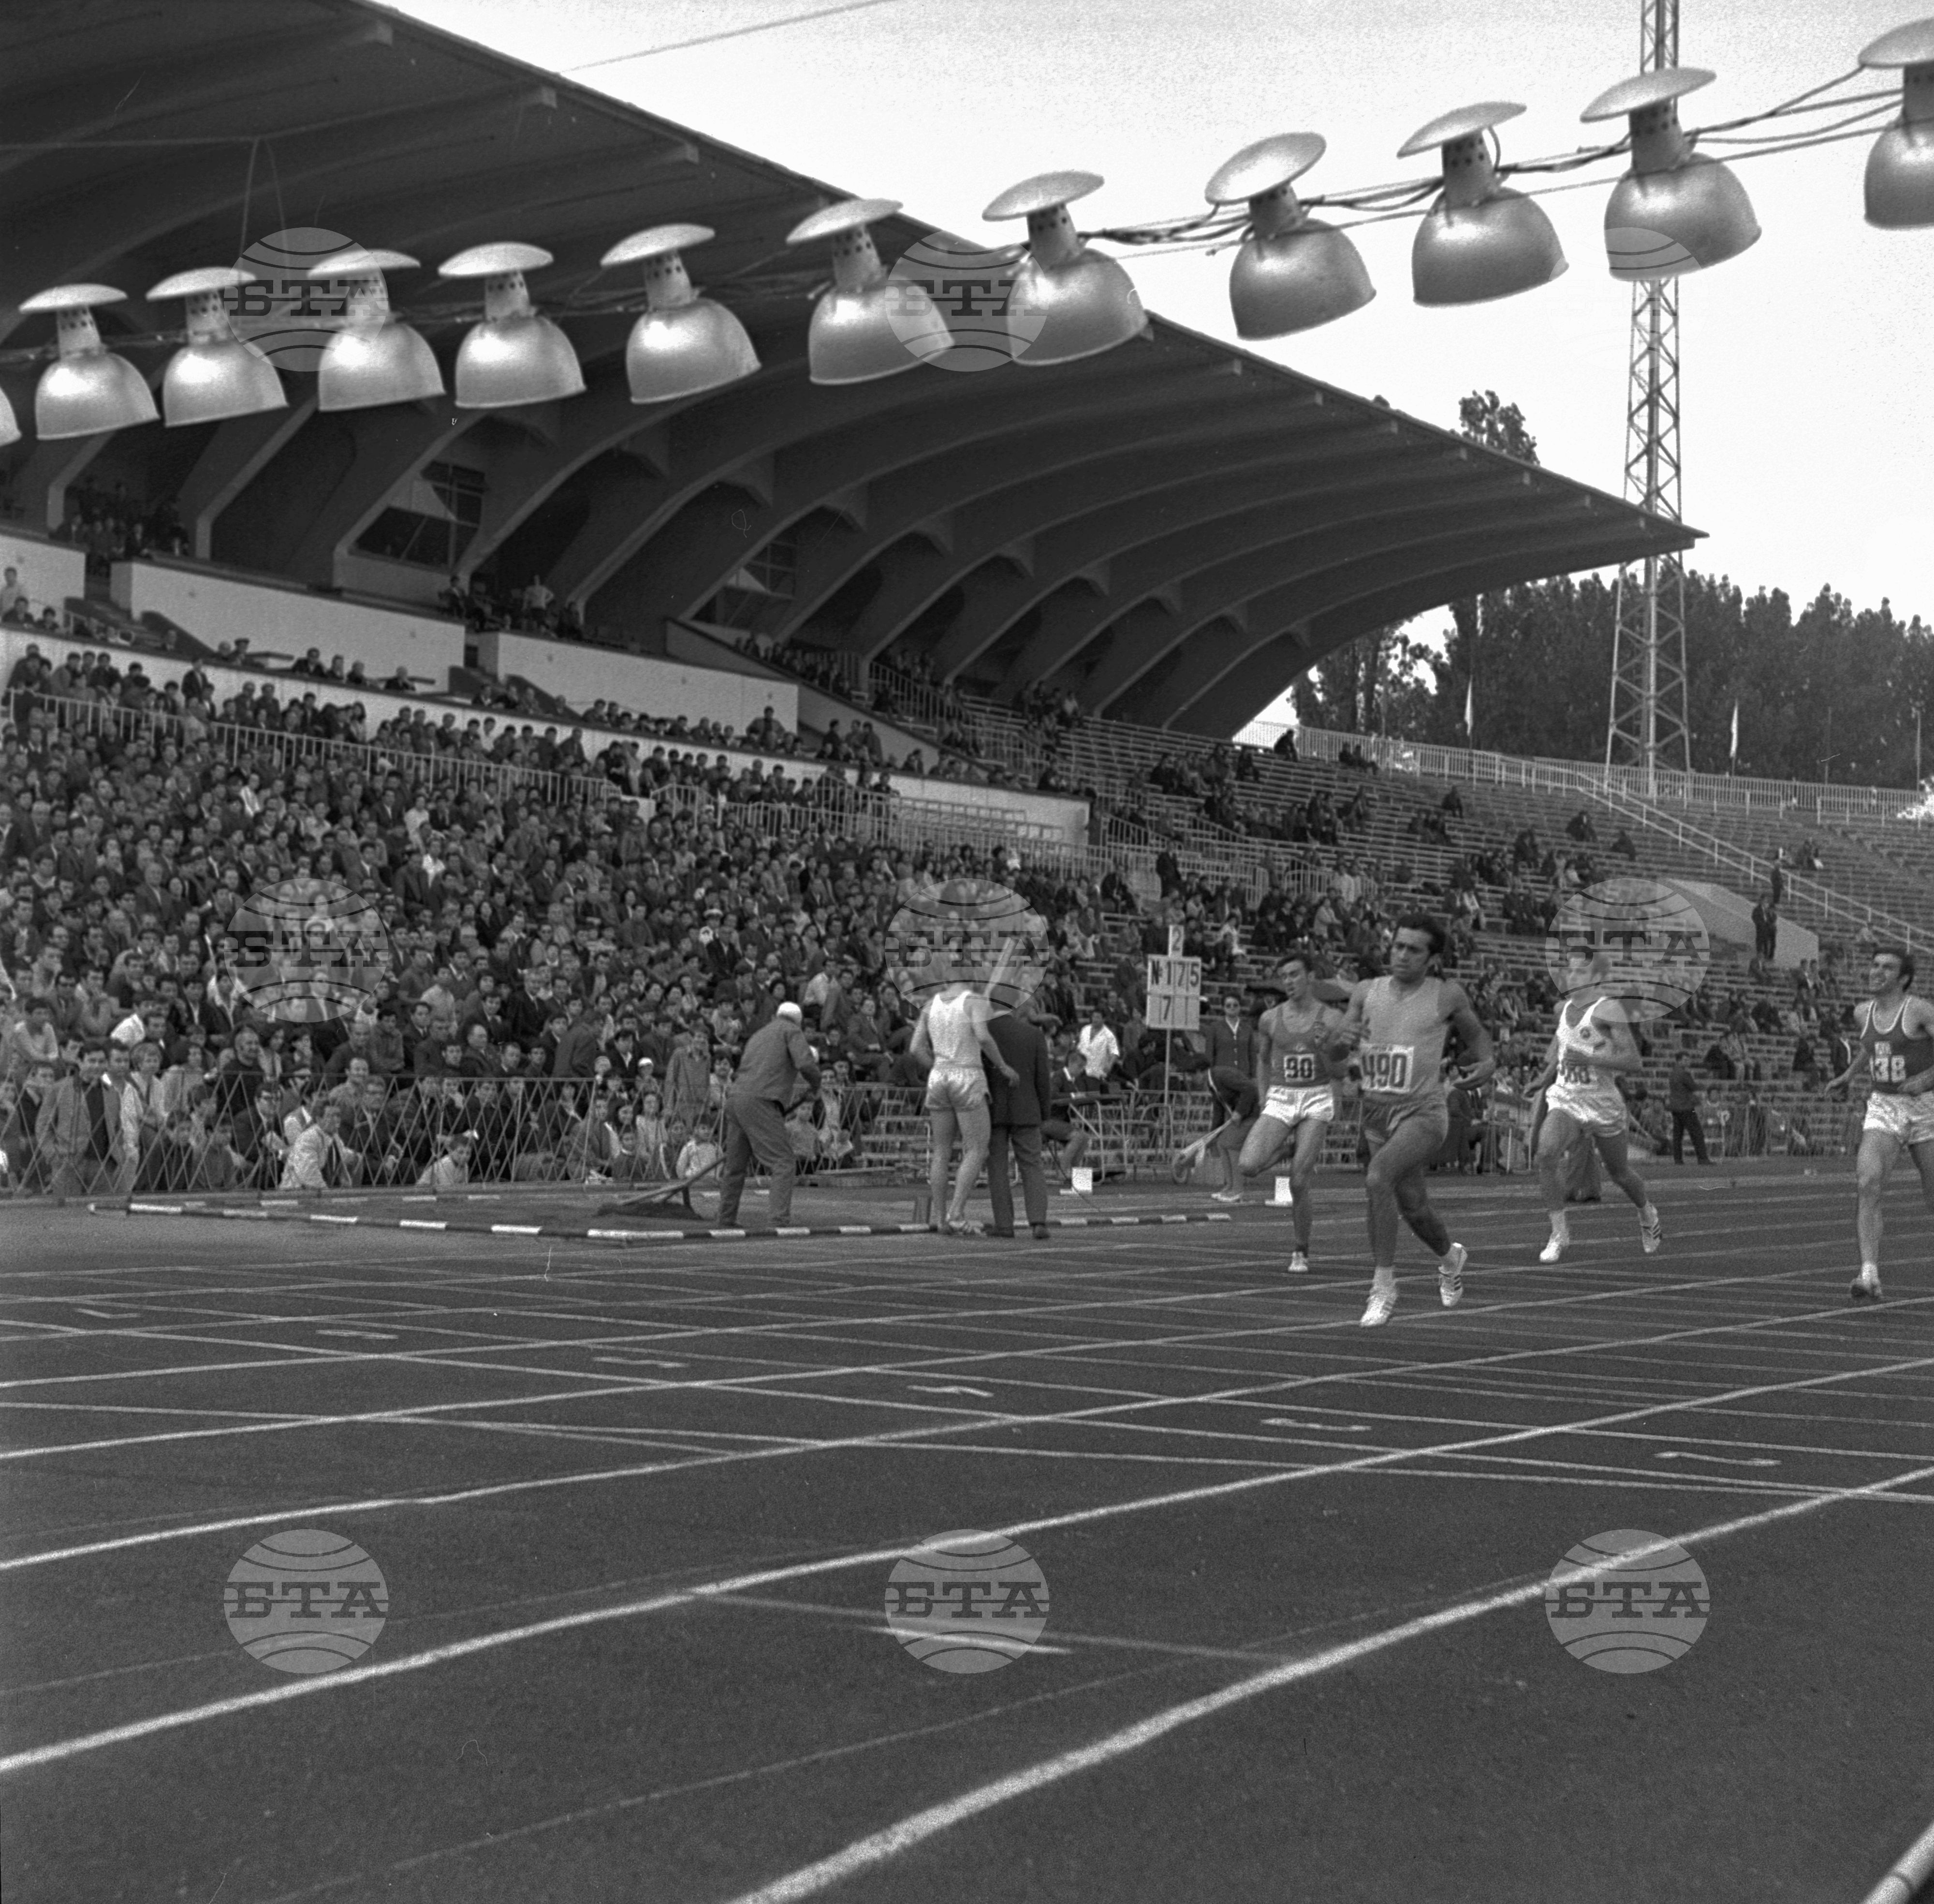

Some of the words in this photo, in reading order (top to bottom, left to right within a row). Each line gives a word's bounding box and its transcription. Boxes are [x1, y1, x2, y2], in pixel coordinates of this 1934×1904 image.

[1172, 928, 1181, 951] 2
[1163, 995, 1171, 1020] 7
[1362, 1053, 1407, 1088] 490
